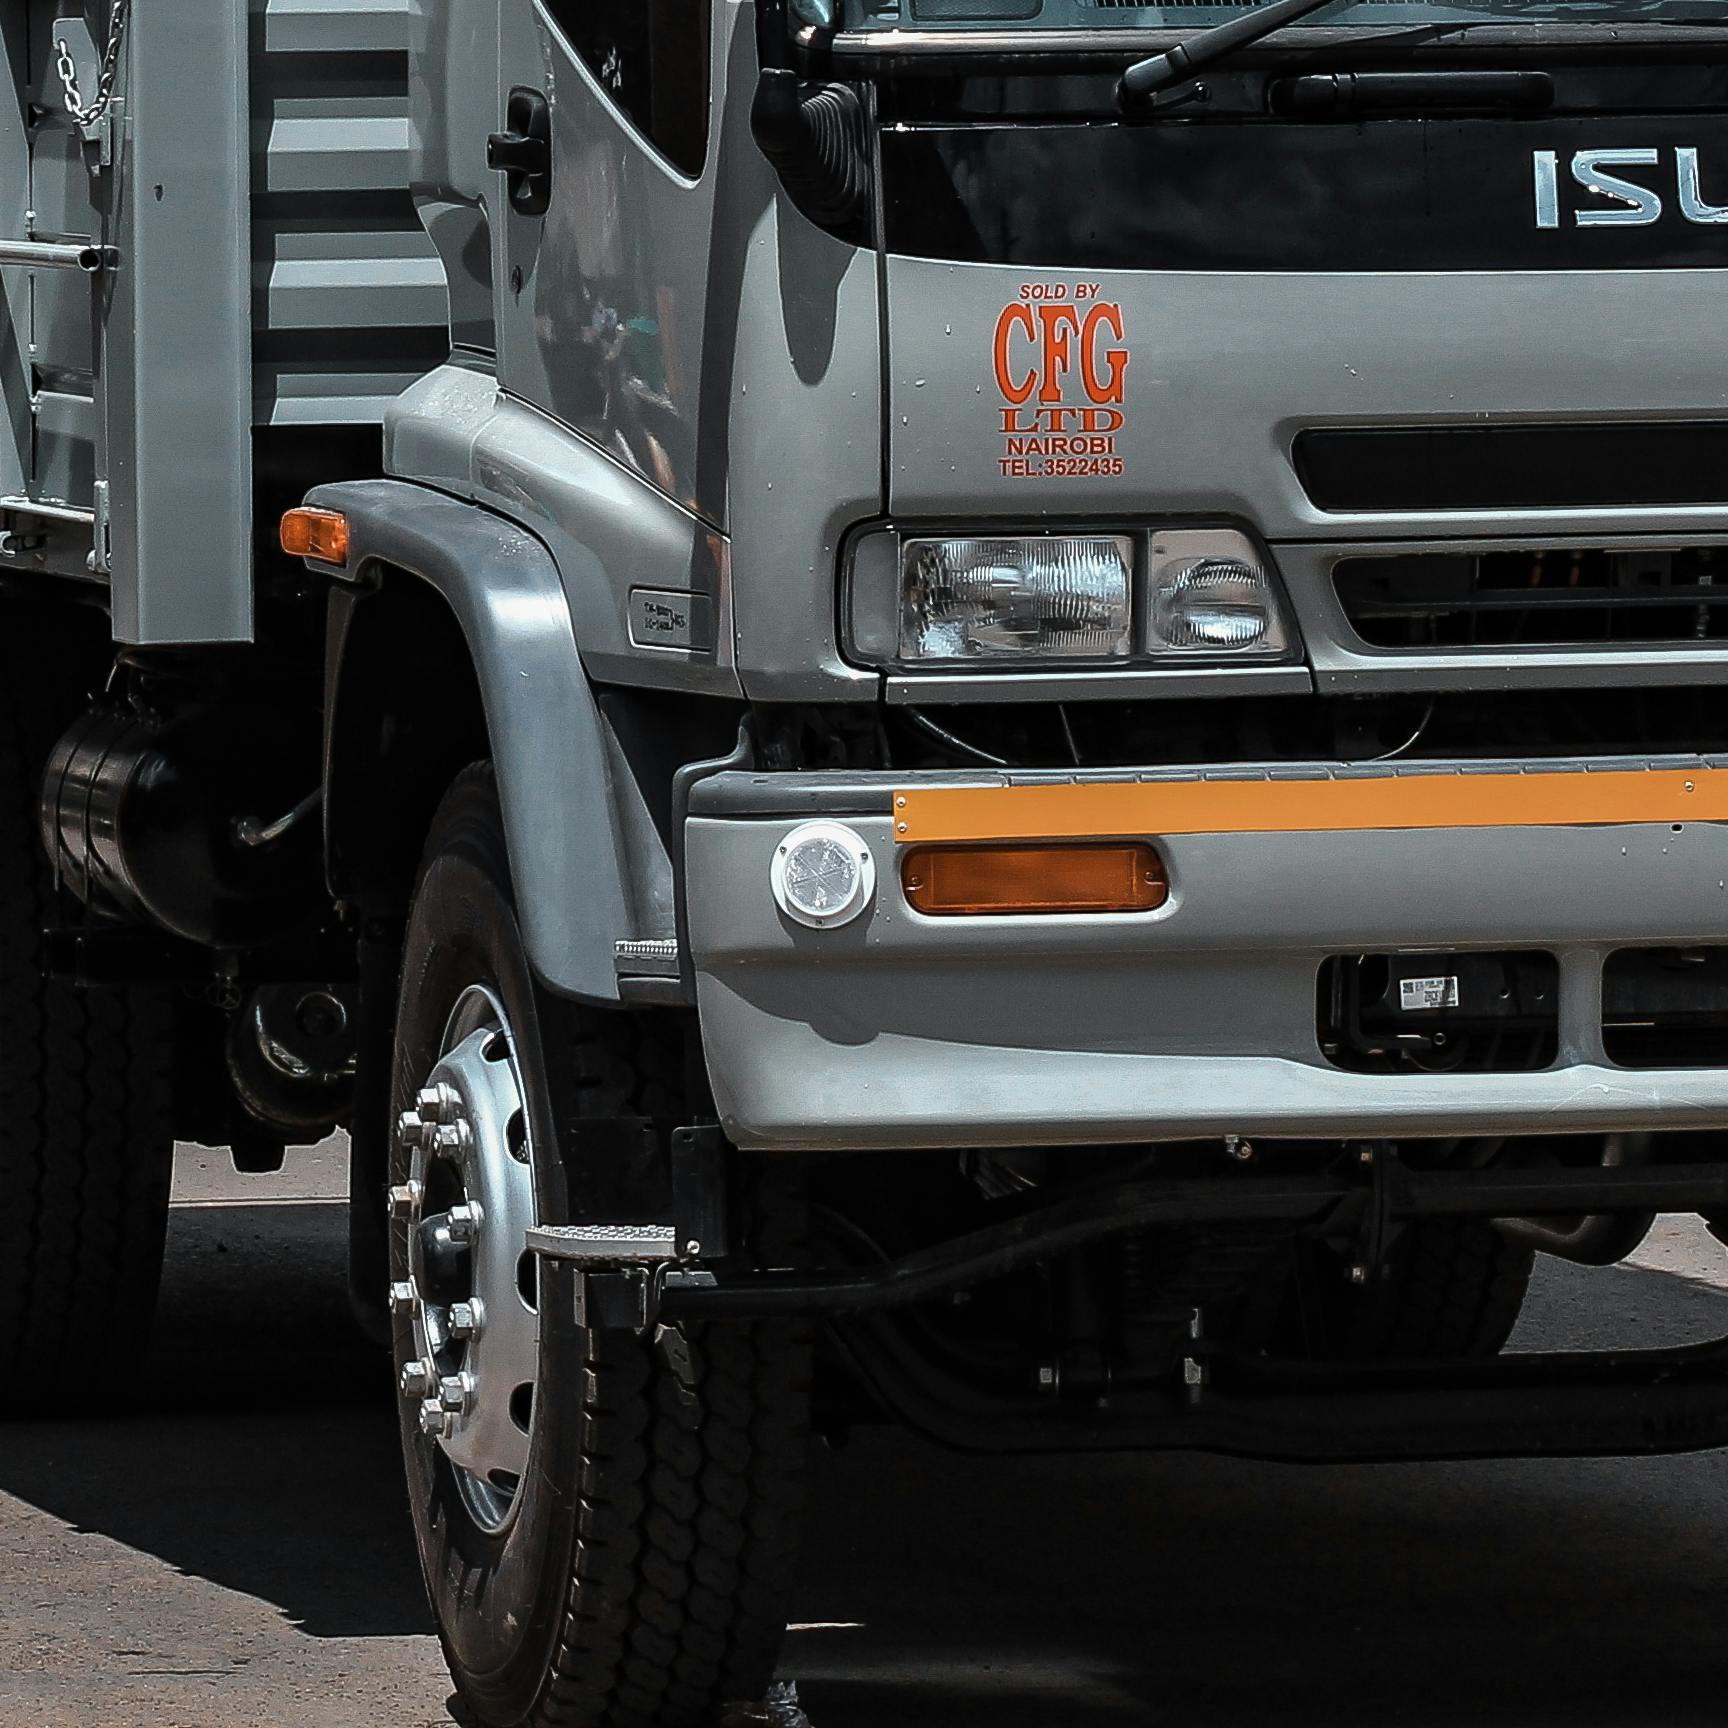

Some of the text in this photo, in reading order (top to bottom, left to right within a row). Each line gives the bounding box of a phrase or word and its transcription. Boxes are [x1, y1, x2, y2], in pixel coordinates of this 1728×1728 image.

[1019, 282, 1100, 300] SOLD BY
[993, 302, 1129, 405] CFG
[998, 407, 1124, 433] LTD
[1007, 436, 1113, 456] NAIROBI
[998, 458, 1124, 477] TEL:3522435
